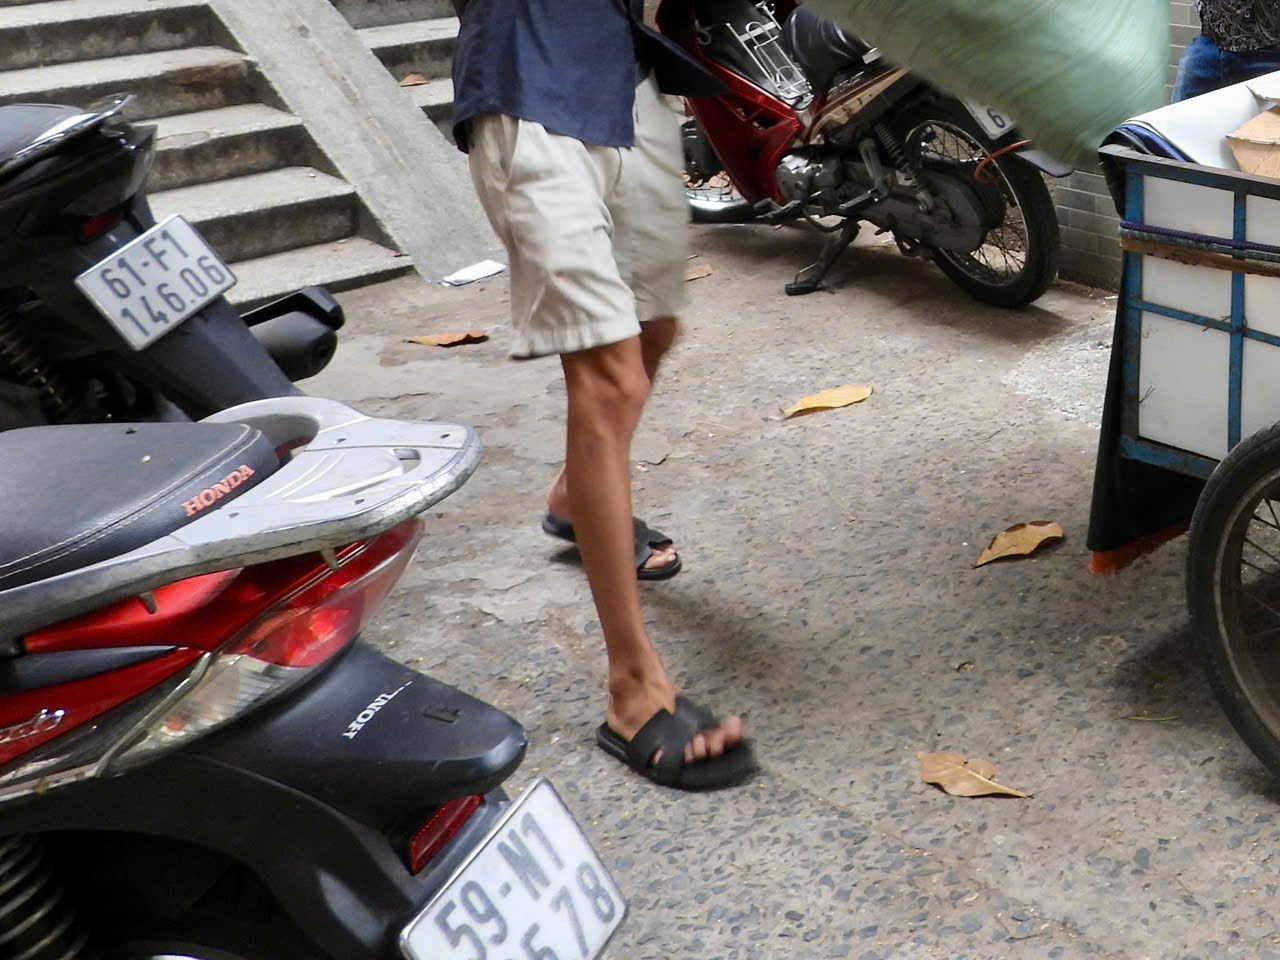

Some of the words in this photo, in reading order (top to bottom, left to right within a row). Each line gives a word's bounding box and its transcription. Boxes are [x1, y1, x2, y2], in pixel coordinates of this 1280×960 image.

[101, 229, 189, 299] 61-F1
[121, 255, 226, 337] 146.06
[180, 464, 256, 517] HONDA
[342, 680, 413, 739] HON
[433, 811, 565, 960] 59-N1
